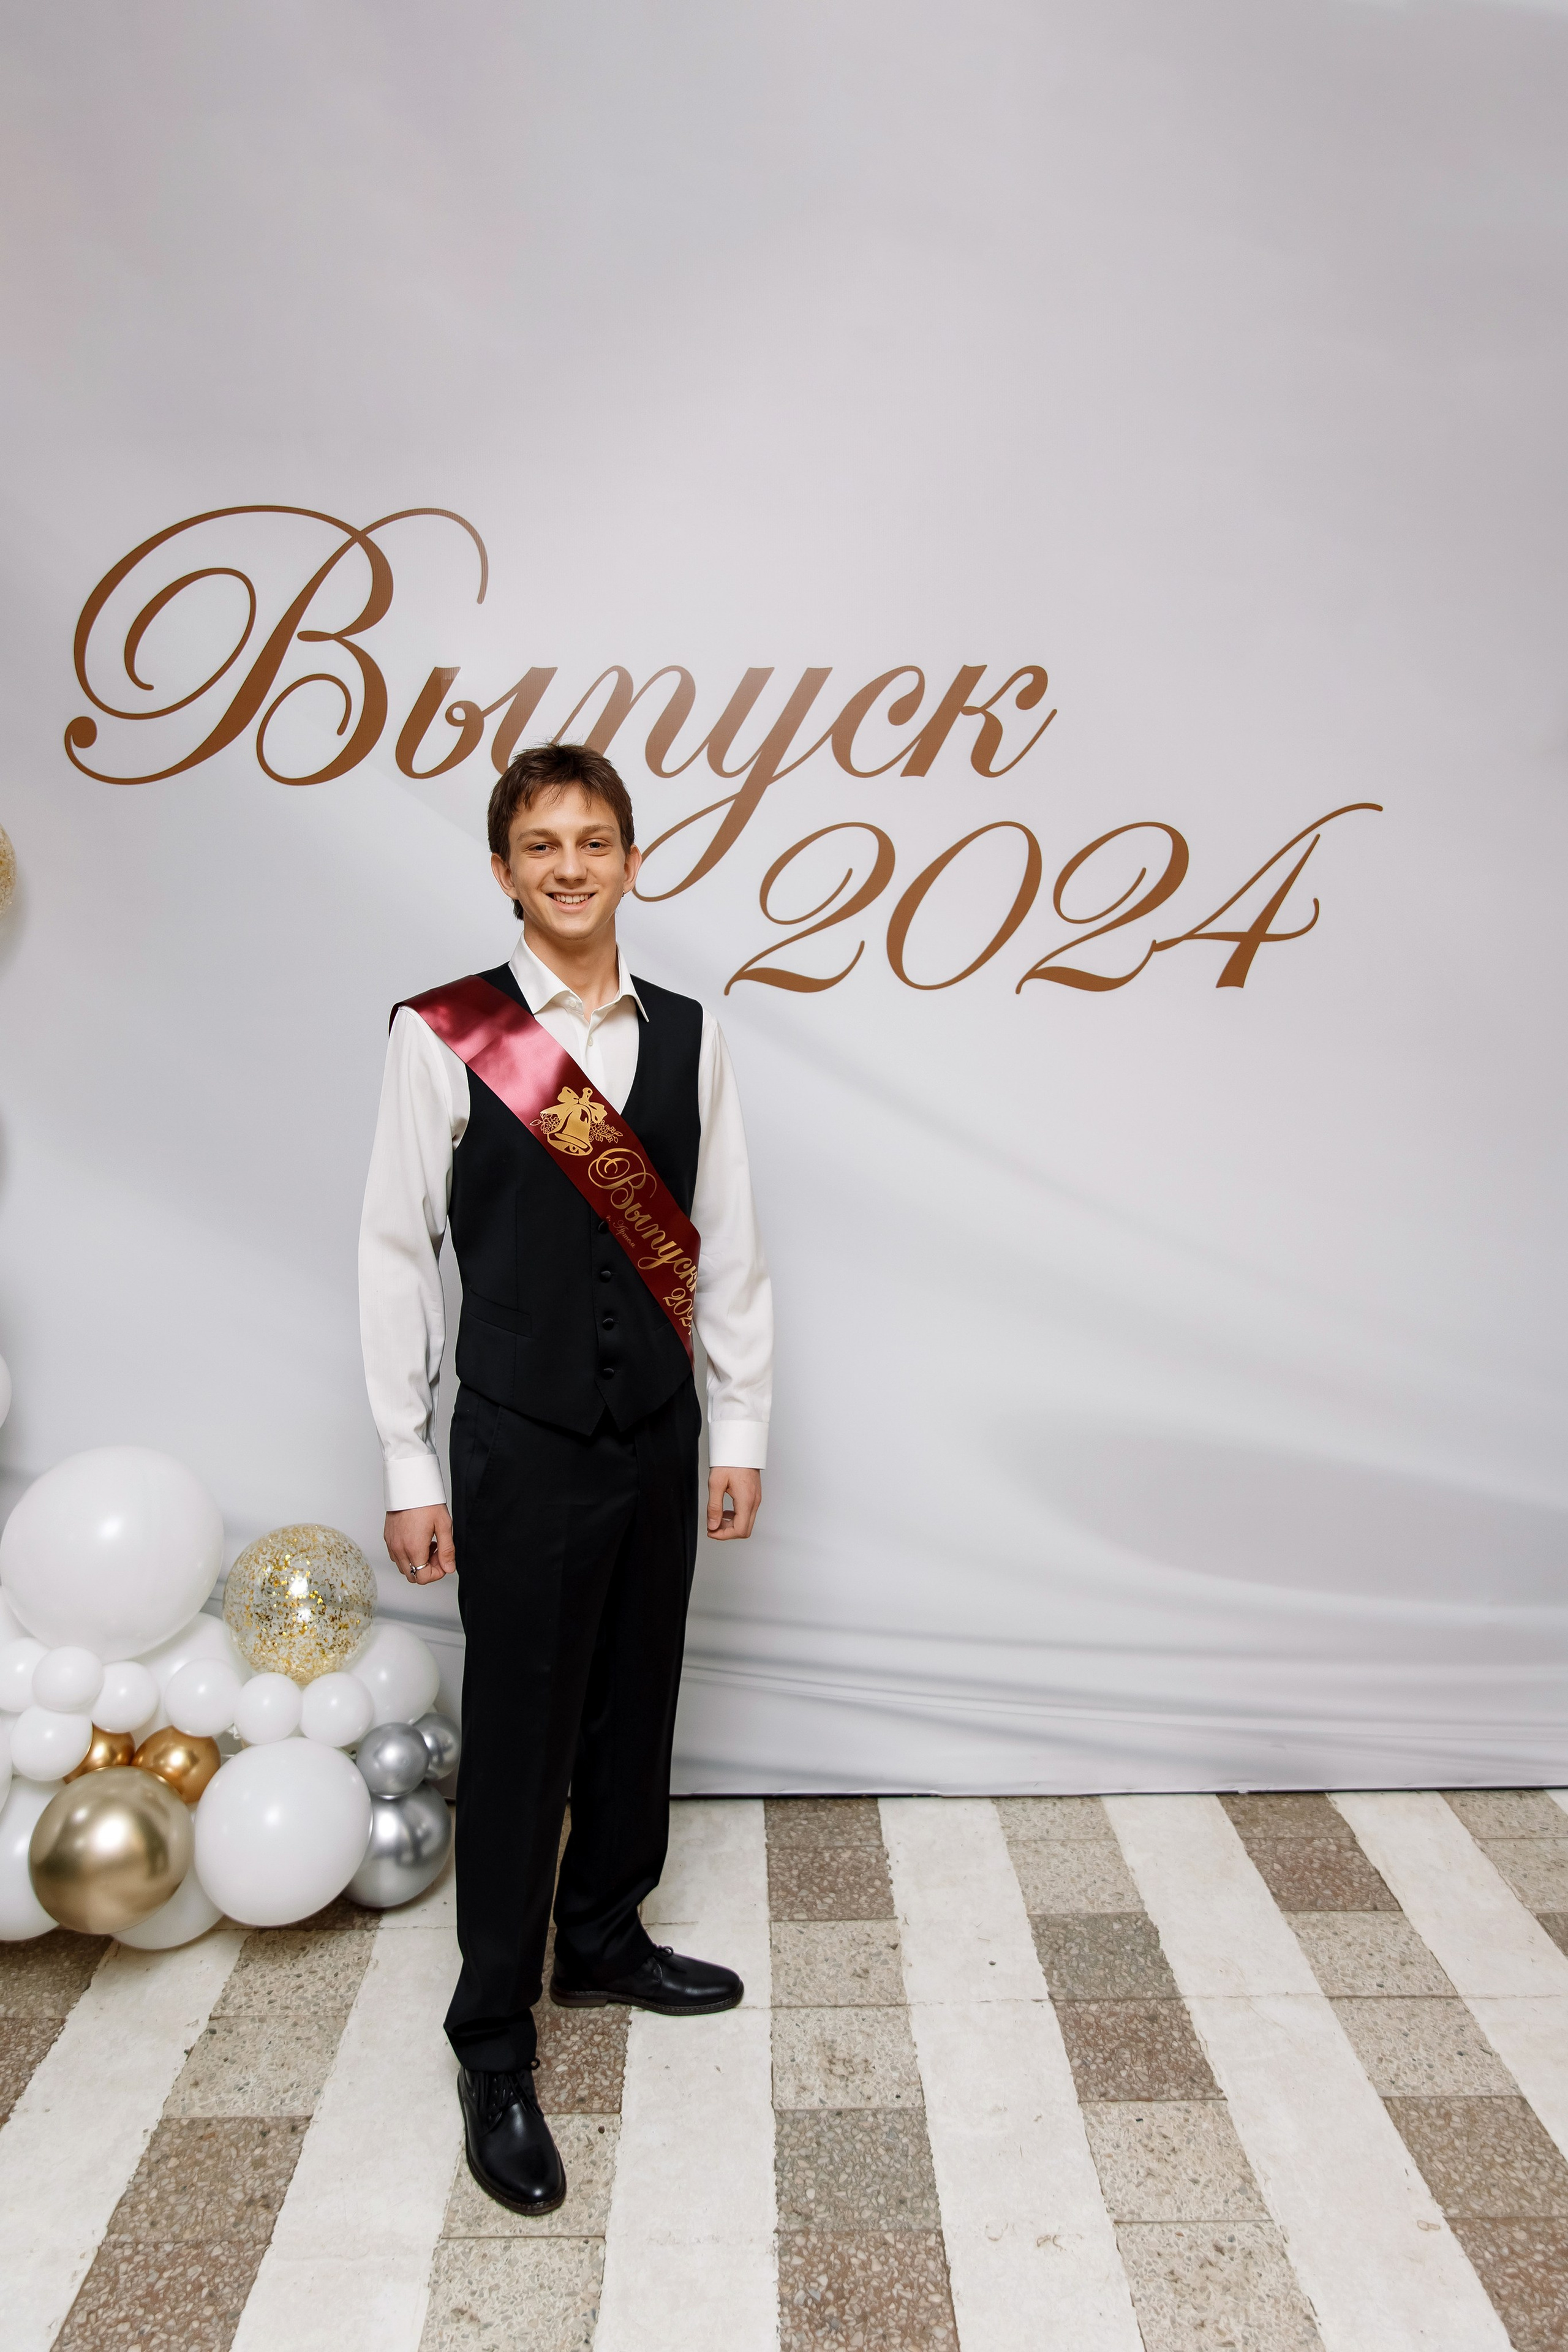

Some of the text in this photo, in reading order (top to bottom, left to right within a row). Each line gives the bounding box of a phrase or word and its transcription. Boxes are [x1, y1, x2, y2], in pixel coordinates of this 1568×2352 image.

[64, 505, 1057, 903] Выпуск
[723, 802, 1384, 997] 2024
[587, 1147, 698, 1292] Выпуск
[662, 1287, 694, 1336] 202
